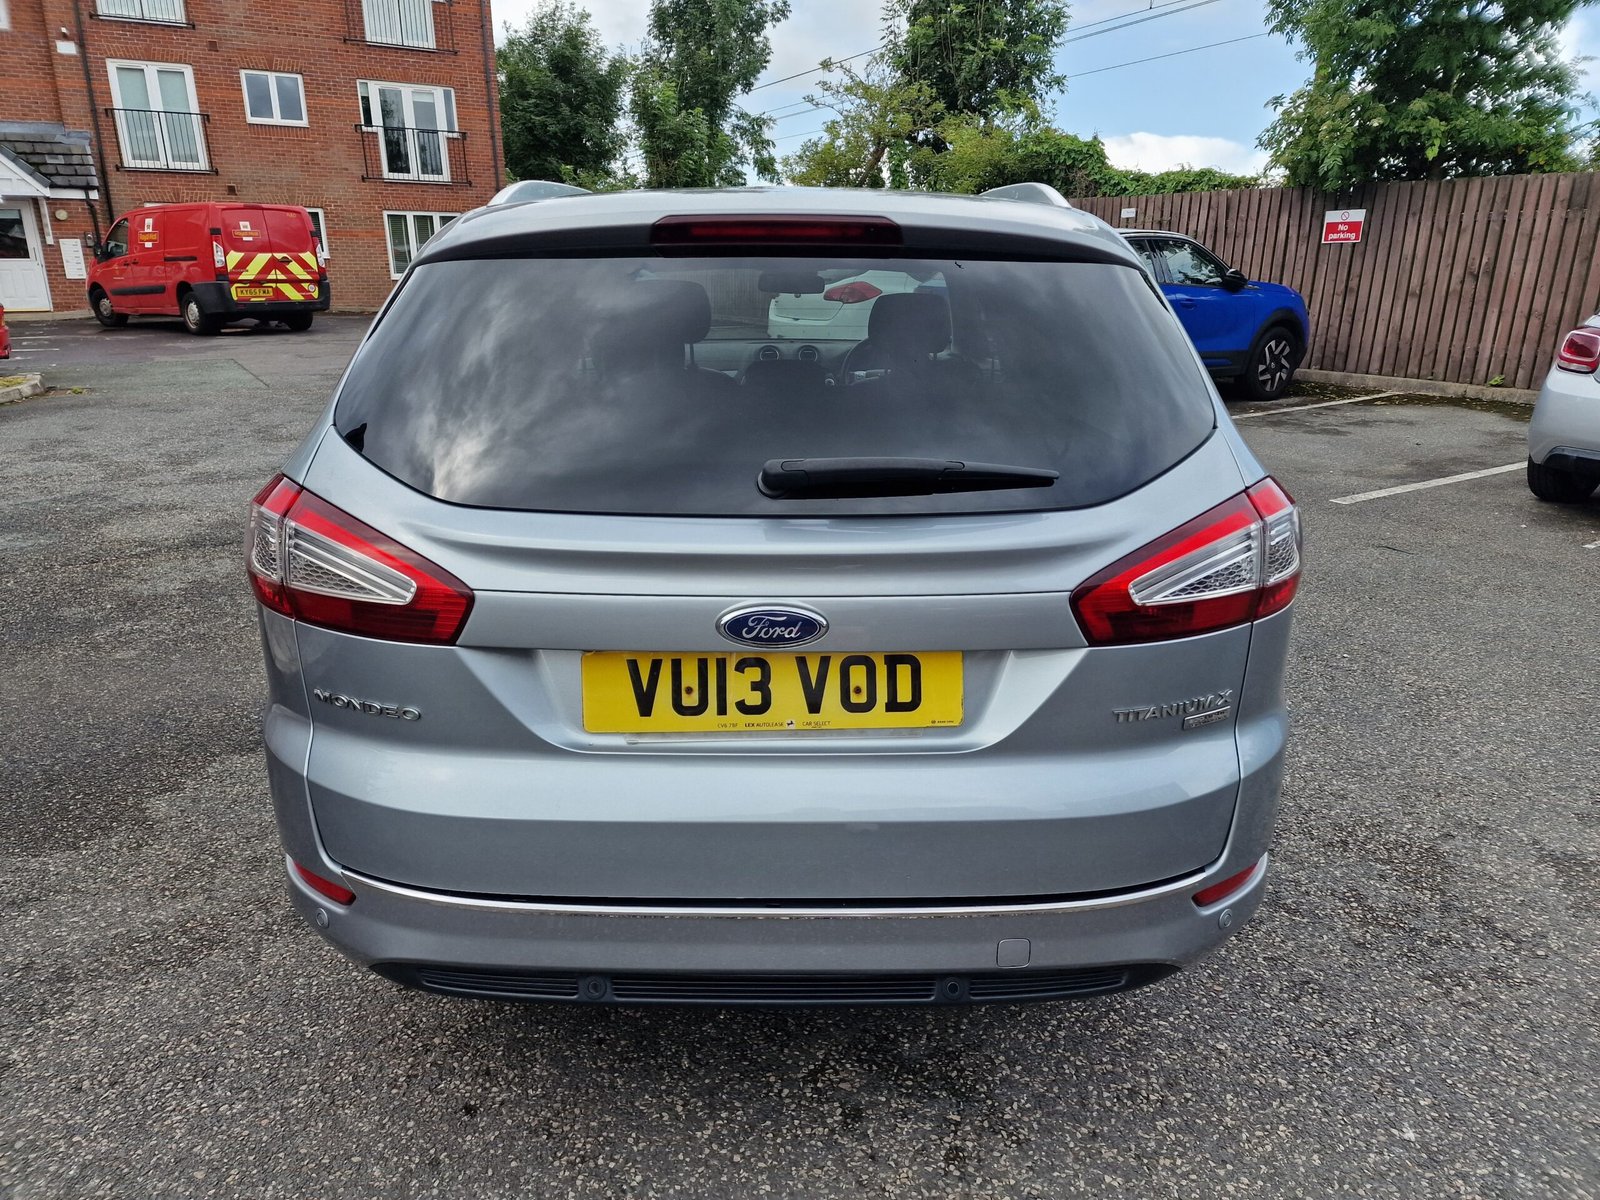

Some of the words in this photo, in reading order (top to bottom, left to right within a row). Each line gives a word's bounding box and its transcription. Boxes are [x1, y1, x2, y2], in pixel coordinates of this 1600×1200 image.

[742, 615, 802, 638] Ford
[626, 657, 772, 717] VU13
[795, 654, 922, 714] VOD
[314, 688, 421, 720] MONDEO
[1112, 695, 1214, 722] TITANIUM
